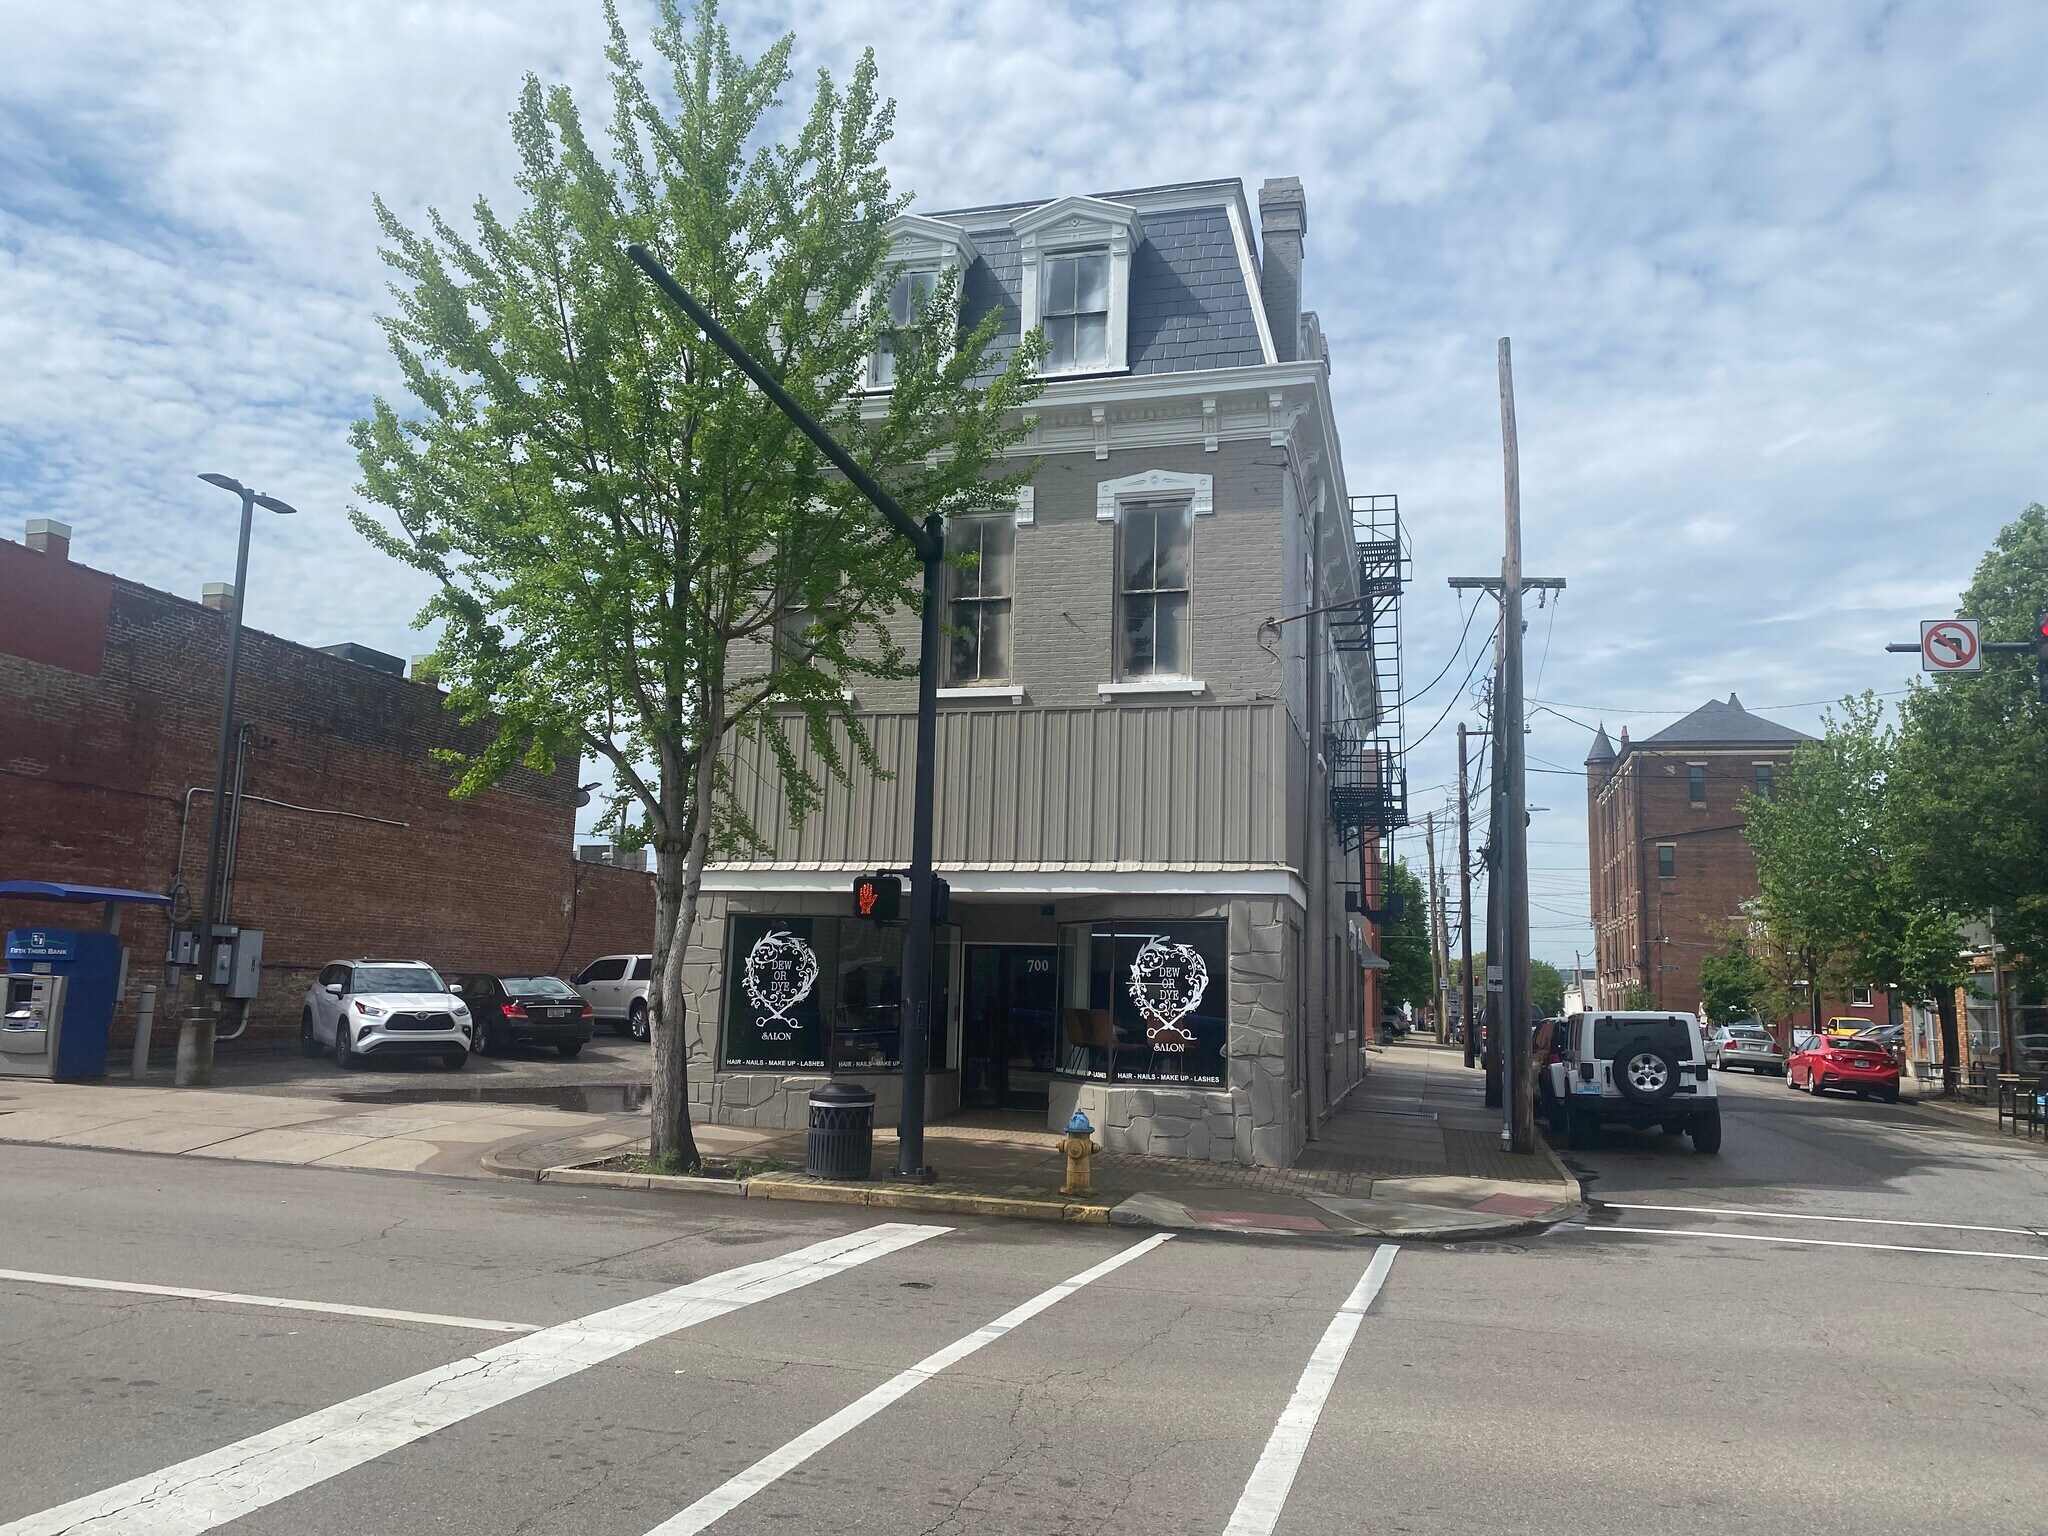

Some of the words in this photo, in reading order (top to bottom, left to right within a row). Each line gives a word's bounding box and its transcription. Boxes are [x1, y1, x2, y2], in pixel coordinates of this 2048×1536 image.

[771, 960, 793, 970] DEW
[1027, 959, 1049, 973] 700
[773, 971, 788, 981] OR
[1159, 967, 1181, 978] DEW
[770, 981, 790, 992] DYE
[1162, 978, 1176, 989] OR
[1160, 989, 1180, 1001] DYE
[761, 1032, 792, 1041] SALON
[1153, 1043, 1185, 1053] SALON
[838, 1060, 852, 1068] HAIR
